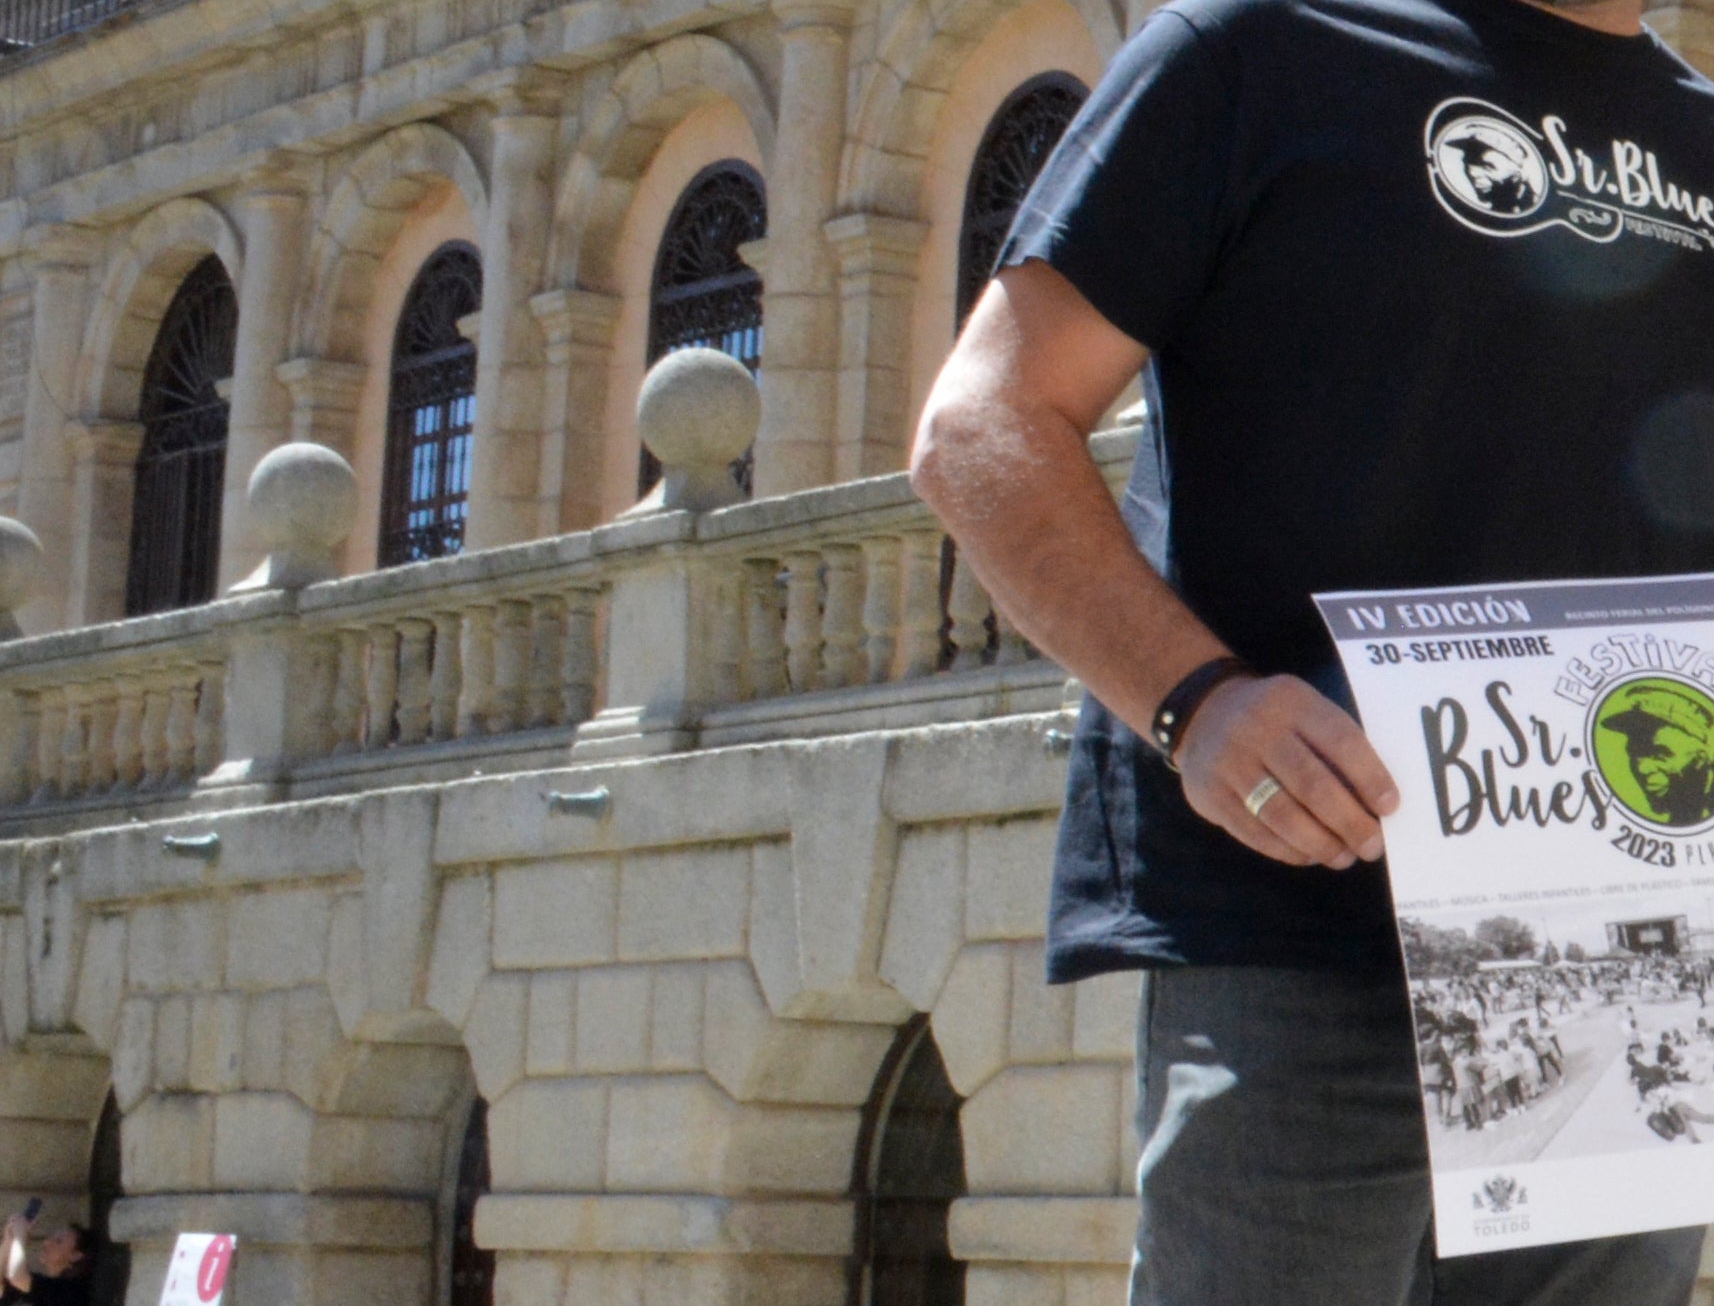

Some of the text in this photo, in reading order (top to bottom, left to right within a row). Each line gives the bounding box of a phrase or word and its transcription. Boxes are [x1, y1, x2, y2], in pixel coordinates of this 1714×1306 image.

[1346, 595, 1532, 632] IV EDICIÓN
[1366, 635, 1555, 666] 30-SEPTIEMBRE
[1484, 680, 1582, 768] Sr.
[1420, 697, 1614, 837] Blues
[1611, 824, 1676, 868] 2023
[1474, 1220, 1531, 1237] TOLEDO
